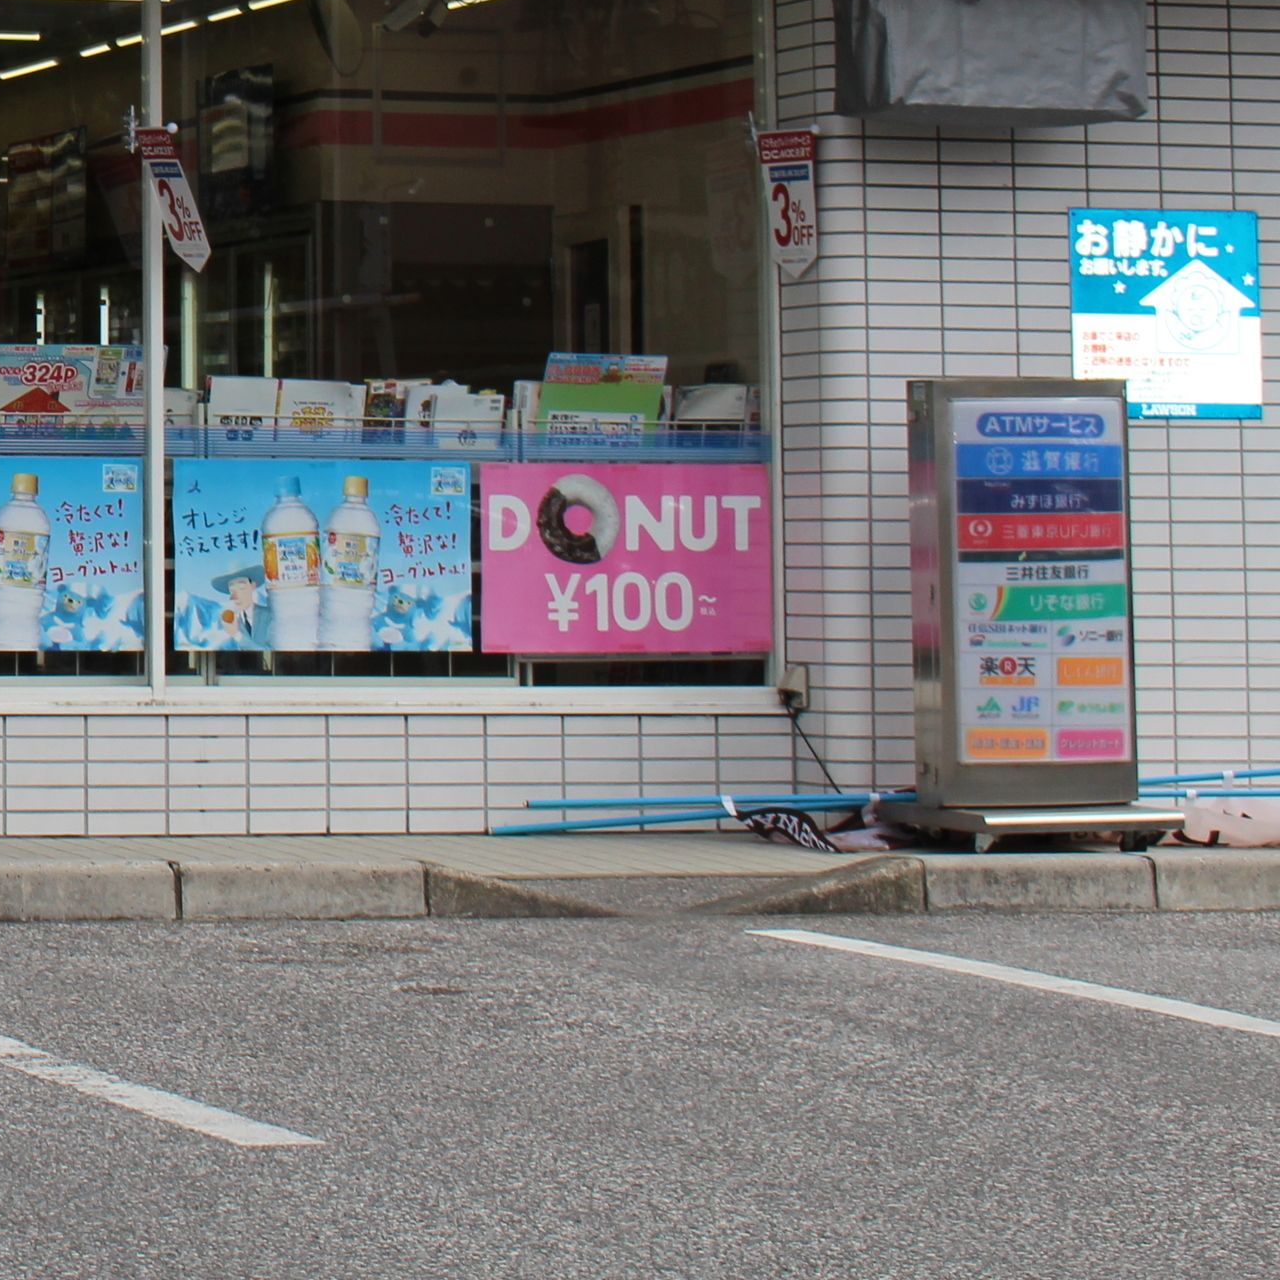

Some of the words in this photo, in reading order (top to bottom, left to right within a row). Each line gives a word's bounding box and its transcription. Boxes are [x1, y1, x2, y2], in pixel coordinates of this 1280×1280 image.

[183, 222, 204, 241] OFF
[792, 225, 814, 246] OFF
[1074, 218, 1219, 258] お静かに
[1141, 403, 1197, 416] LAWSON
[984, 415, 1099, 435] ATMサービス
[1022, 450, 1100, 472] 滋賀銀行
[55, 498, 123, 524] 冷たくて!
[1010, 493, 1082, 510] みずほ銀行
[182, 507, 248, 530] オレンジ
[385, 501, 452, 526] 冷たくて!
[1003, 524, 1112, 539] 三菱東京UFJ銀行
[69, 529, 129, 556] 贅沢な!
[179, 529, 259, 556] 冷えてます!
[398, 531, 458, 557] 贅沢な!
[1006, 564, 1089, 581] 三井住友銀行
[1030, 594, 1105, 611] りそな銀行
[968, 623, 1048, 634] 住信SBIネット銀行
[1079, 630, 1123, 642] ソニー銀行
[1061, 738, 1121, 749] クレジットカード
